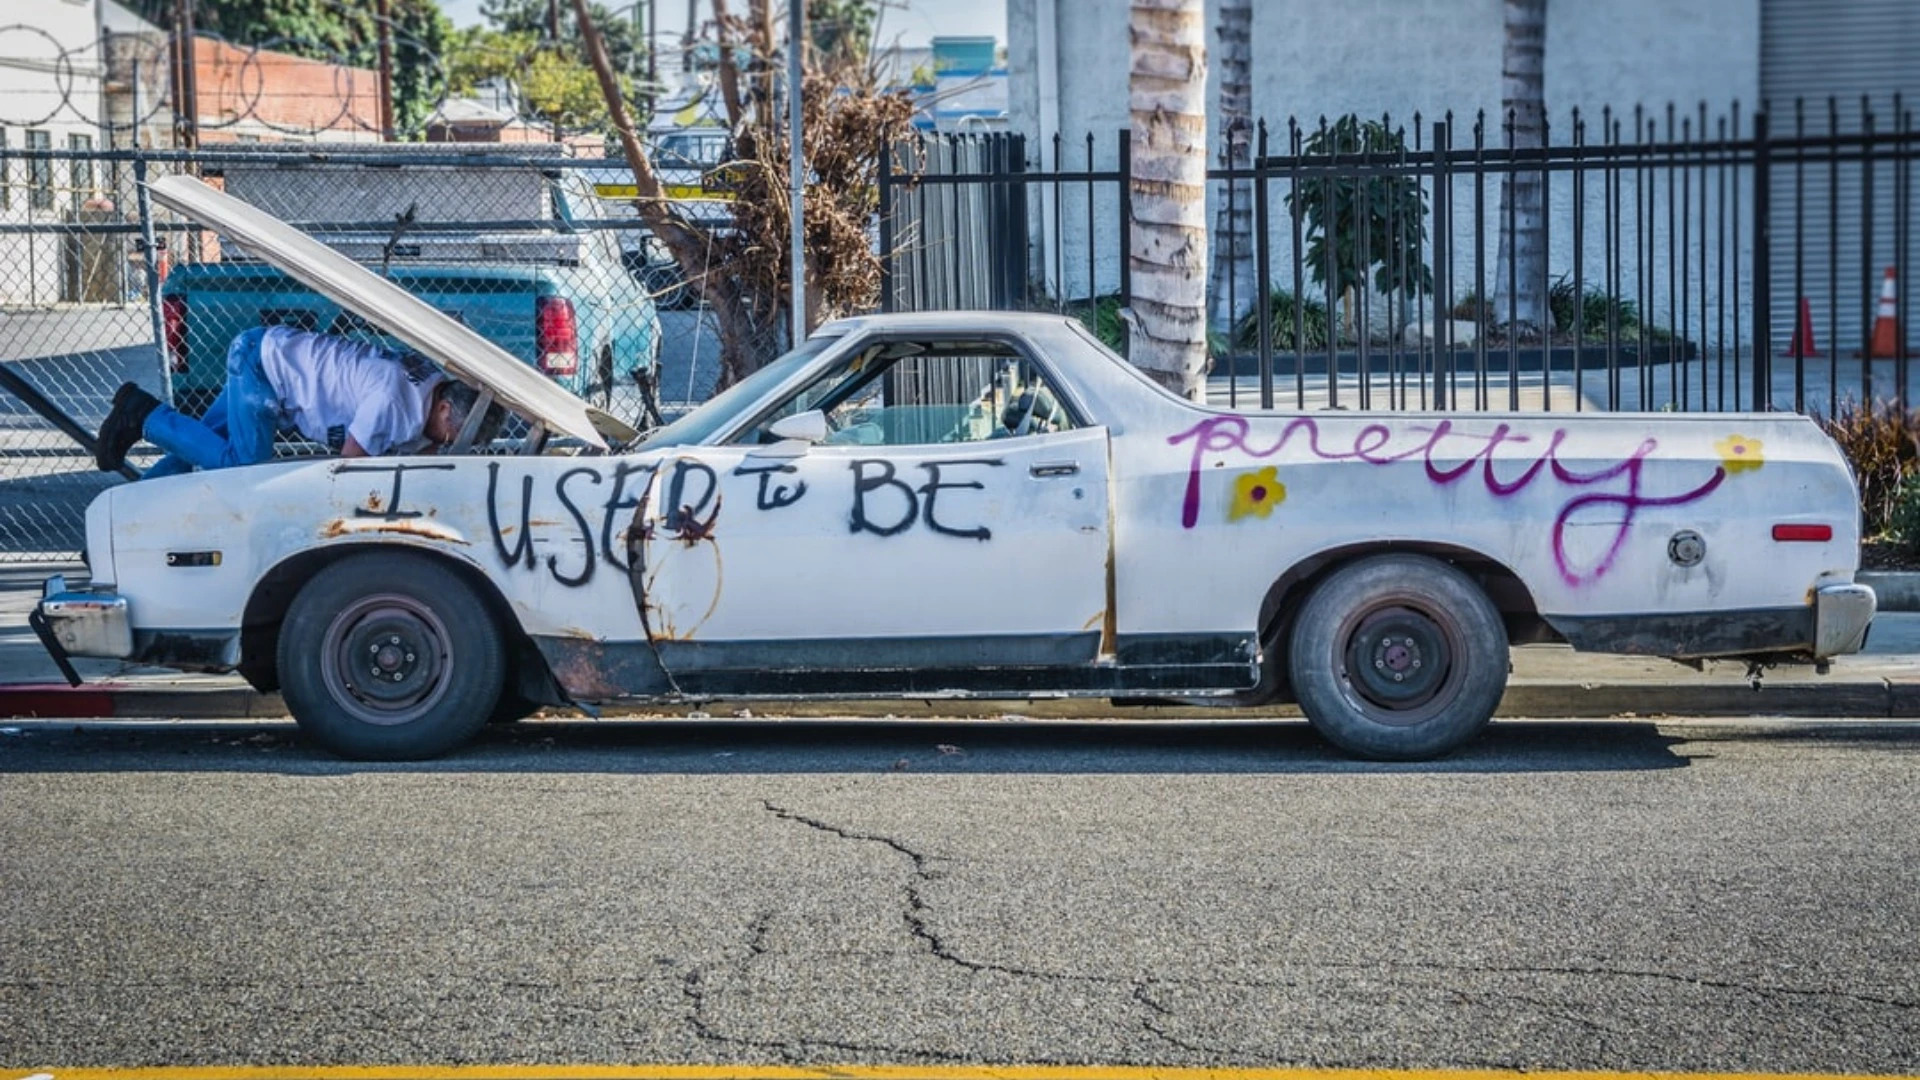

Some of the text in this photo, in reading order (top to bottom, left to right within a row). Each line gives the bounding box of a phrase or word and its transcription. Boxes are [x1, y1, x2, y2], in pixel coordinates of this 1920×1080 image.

[332, 462, 456, 521] I
[487, 459, 721, 588] USED
[849, 458, 1006, 541] BE
[1167, 415, 1725, 586] pretty
